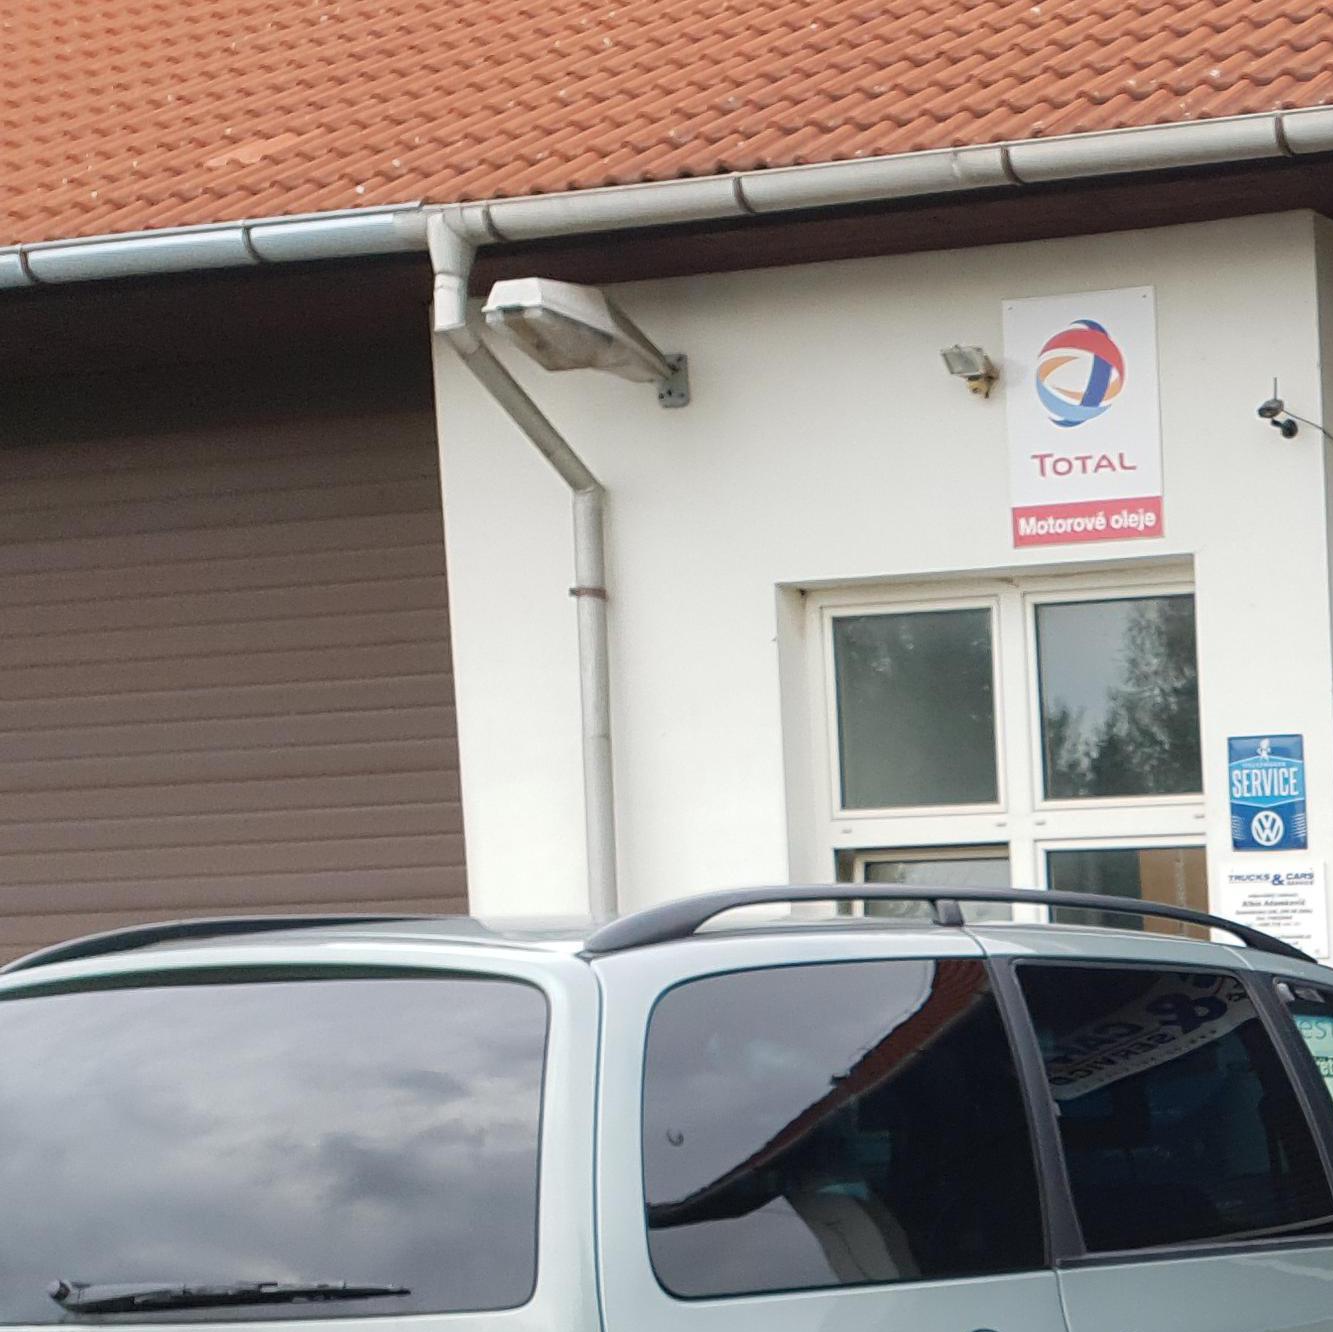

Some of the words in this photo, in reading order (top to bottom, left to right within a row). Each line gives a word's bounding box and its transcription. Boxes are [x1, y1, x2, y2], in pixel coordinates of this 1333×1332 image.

[1030, 452, 1137, 478] TOTAL
[1017, 511, 1106, 537] Motorové
[1110, 508, 1157, 533] oleje
[1231, 767, 1300, 798] SERVICE
[1228, 874, 1270, 882] TRUCKS
[1286, 872, 1315, 880] CARS
